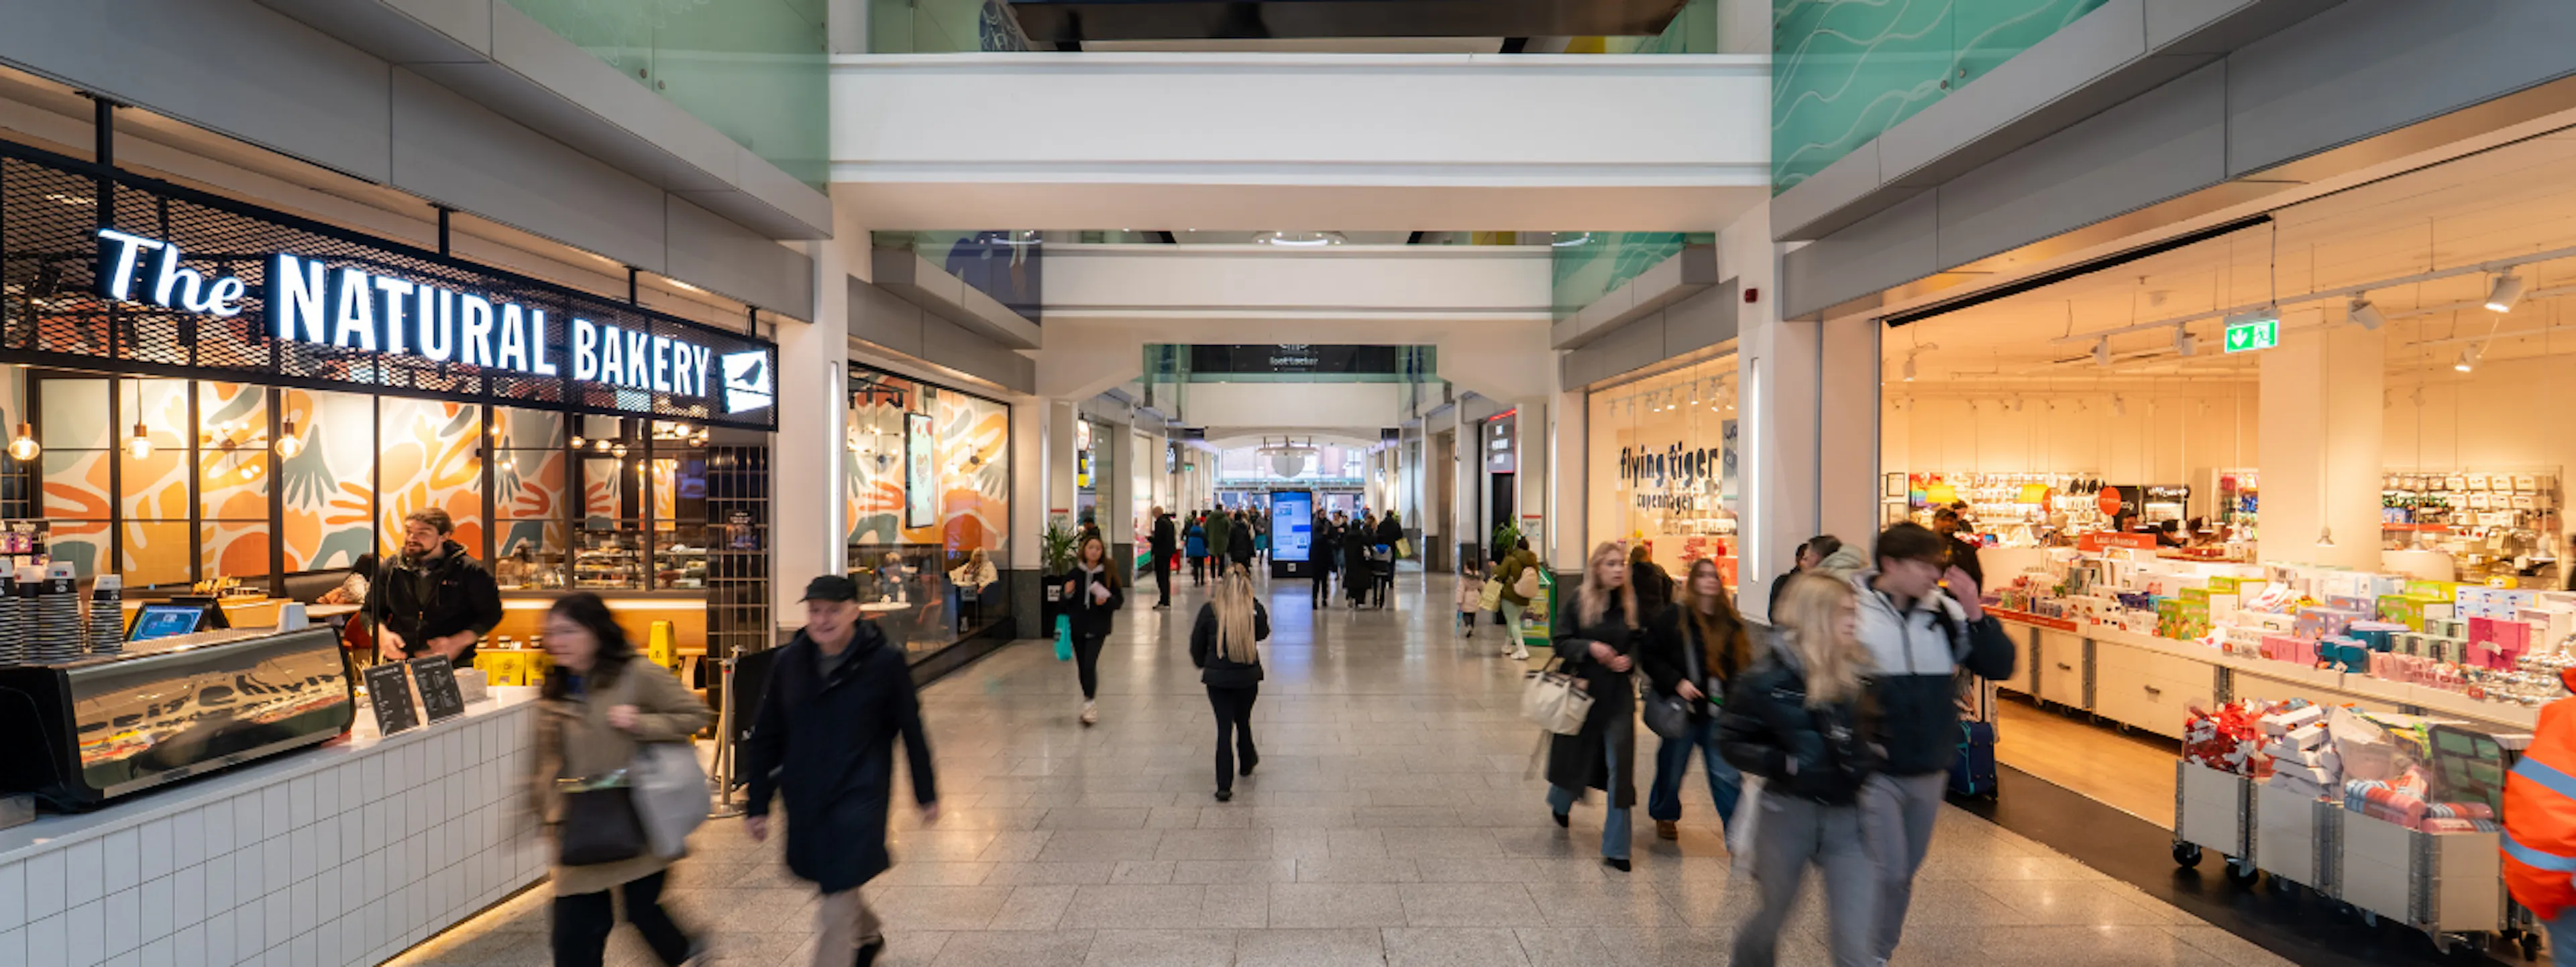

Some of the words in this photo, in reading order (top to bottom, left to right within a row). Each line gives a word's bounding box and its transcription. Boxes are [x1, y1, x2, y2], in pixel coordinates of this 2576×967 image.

[97, 228, 245, 317] The
[279, 252, 557, 376] NATURAL
[573, 317, 711, 398] BAKERY
[1621, 444, 1664, 487] flying
[1668, 440, 1718, 487] tiger
[1637, 491, 1695, 515] copenhagen
